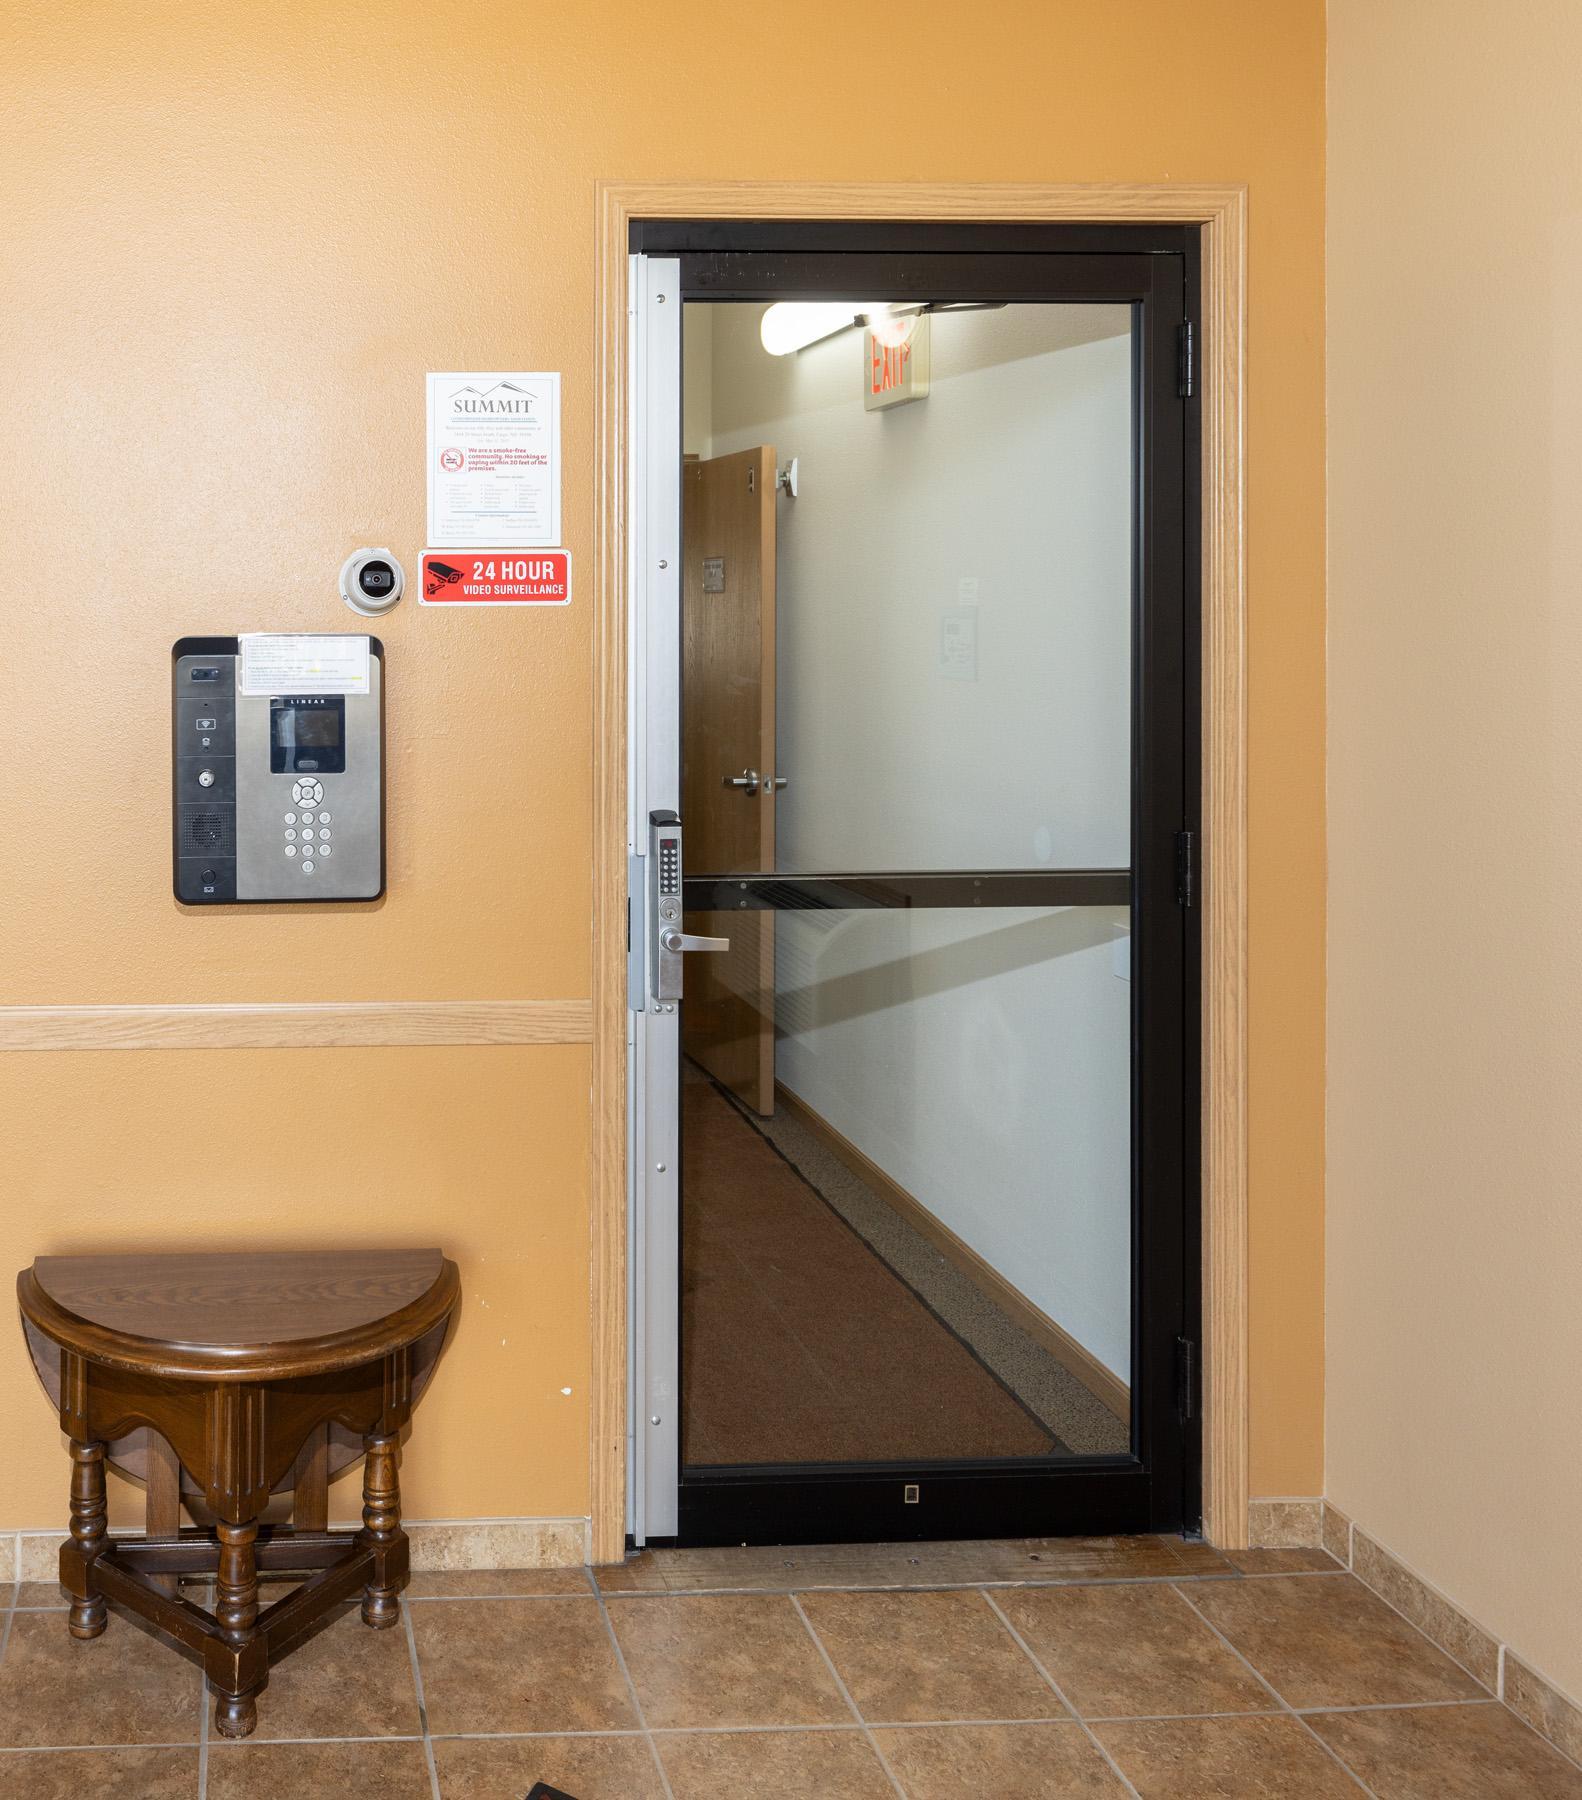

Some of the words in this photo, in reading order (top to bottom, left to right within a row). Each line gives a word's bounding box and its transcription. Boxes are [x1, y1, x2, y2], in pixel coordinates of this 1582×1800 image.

[871, 324, 905, 394] EXIT
[454, 399, 533, 413] SUMMIT
[468, 453, 502, 461] community.
[514, 453, 540, 461] smoking
[473, 561, 496, 580] 24
[501, 560, 555, 580] HOUR
[463, 584, 491, 595] VIDEO
[494, 584, 564, 595] SURVEILLANCE
